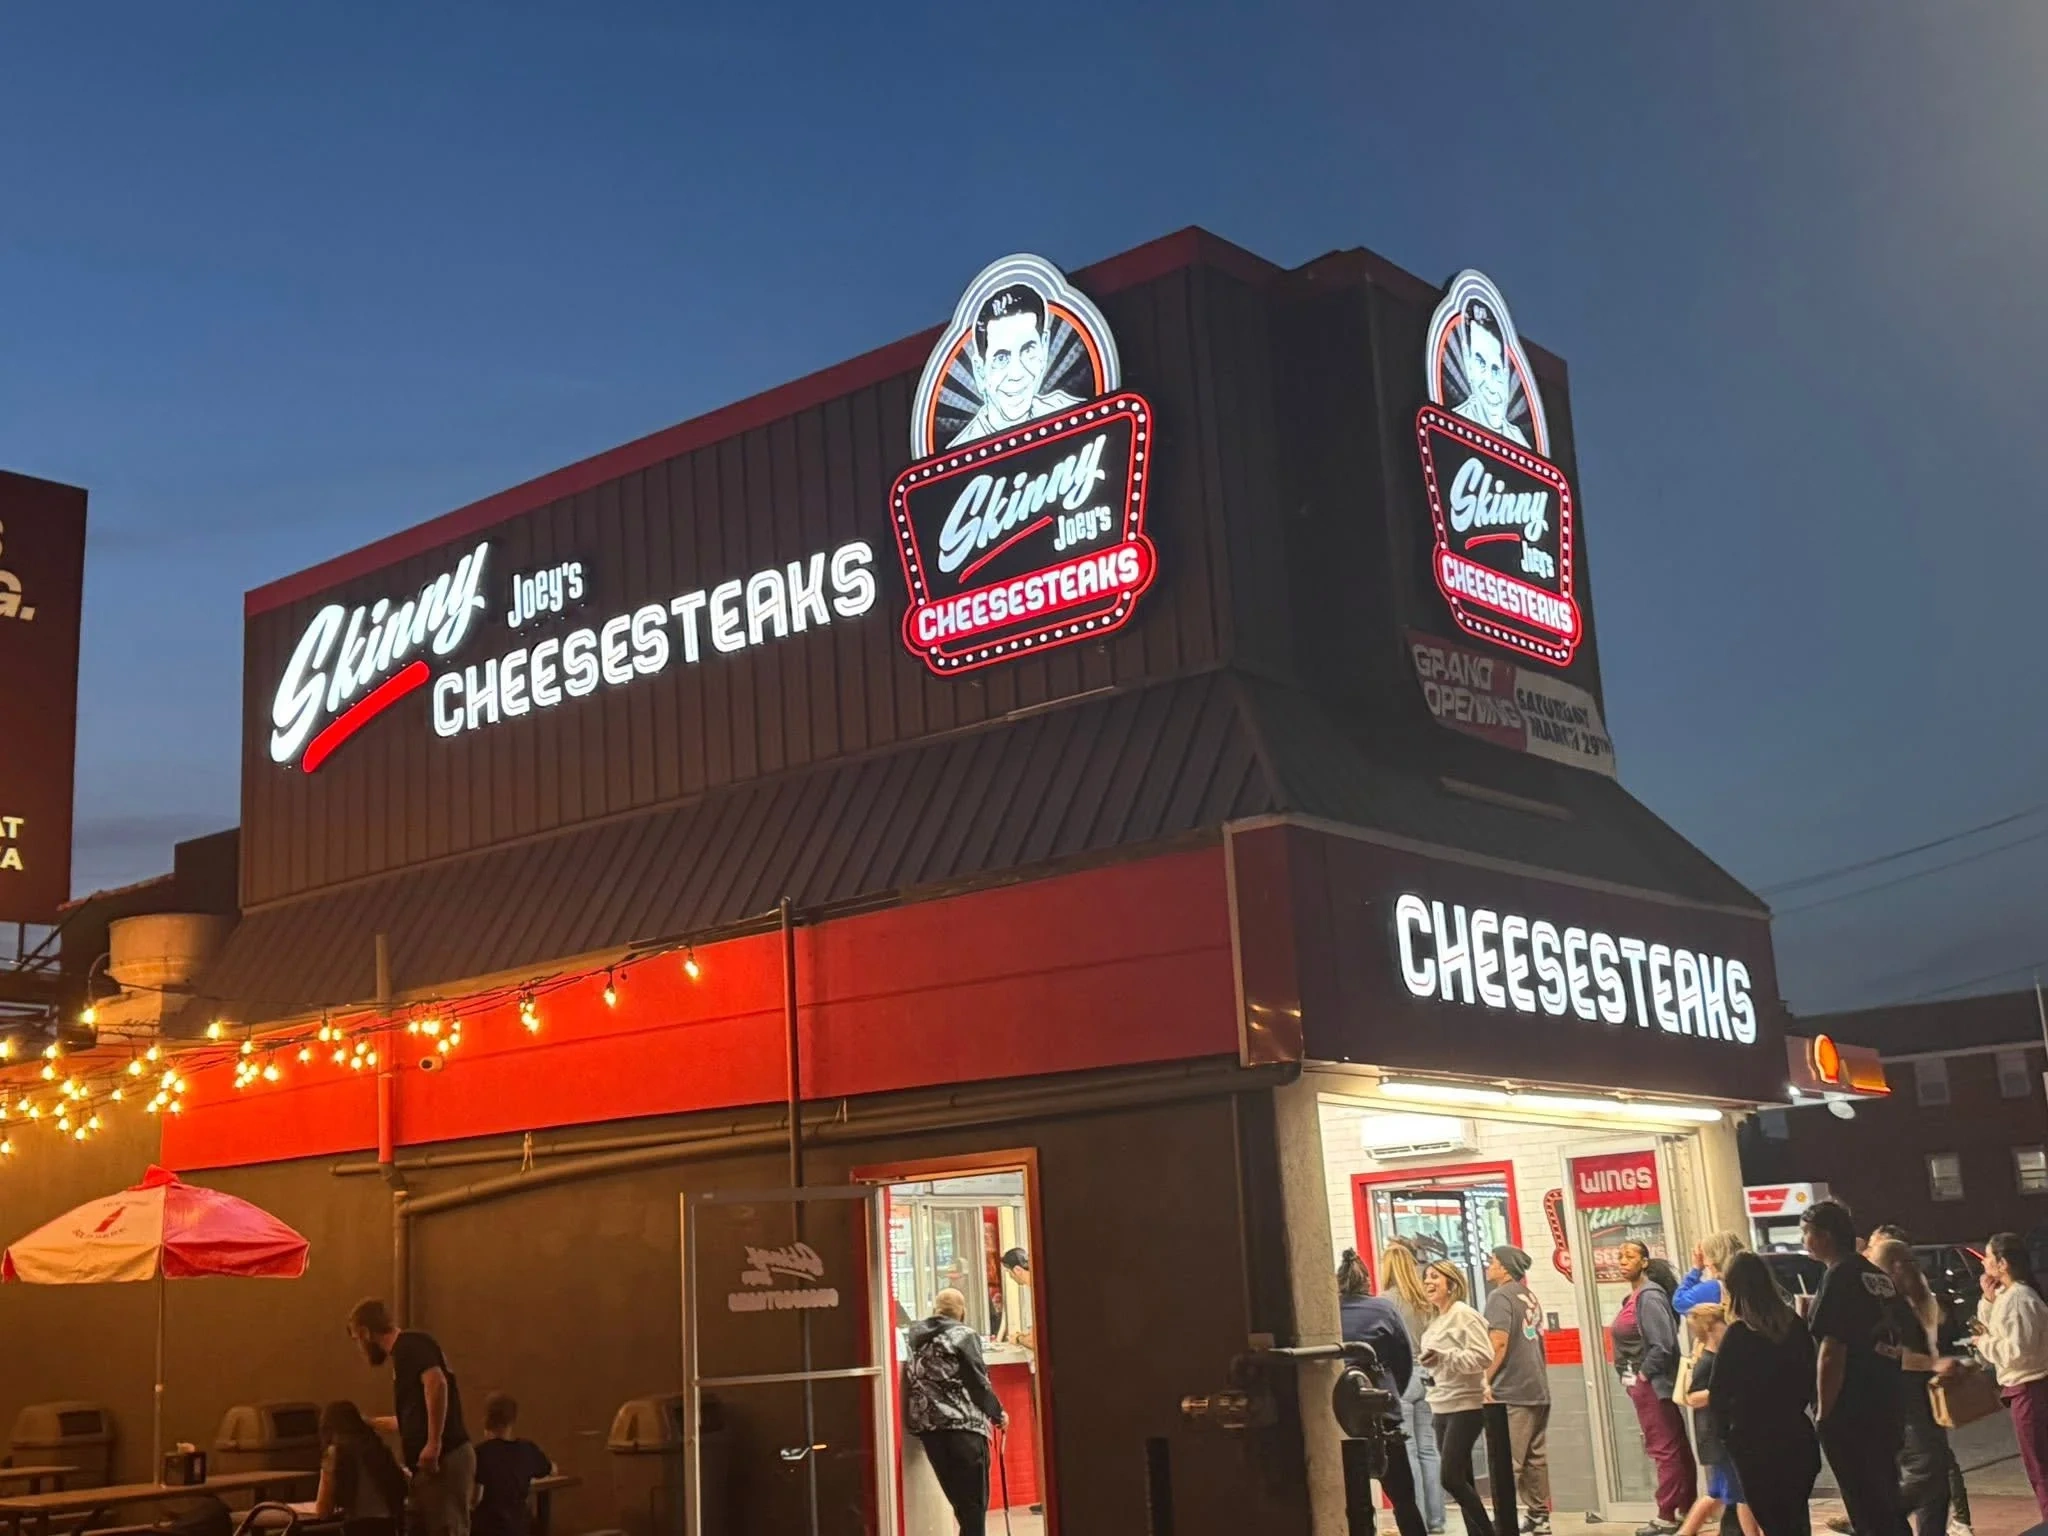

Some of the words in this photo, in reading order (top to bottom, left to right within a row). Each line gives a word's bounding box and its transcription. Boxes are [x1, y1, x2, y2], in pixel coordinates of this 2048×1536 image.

[938, 433, 1107, 572] Skinny
[1053, 505, 1112, 552] Joey's
[1450, 457, 1549, 542] Skinny
[917, 547, 1140, 642] CHEESESTEAKS
[1441, 555, 1573, 634] CHEESESTEAKS
[270, 541, 489, 763] Skinny
[507, 563, 583, 628] Joey's
[433, 541, 876, 737] CHEESESTEAKS
[1412, 643, 1494, 691] GRAND
[1423, 680, 1522, 729] OPENING
[1395, 894, 1756, 1044] CHEESESTEAKS
[1579, 1166, 1653, 1194] WINGS
